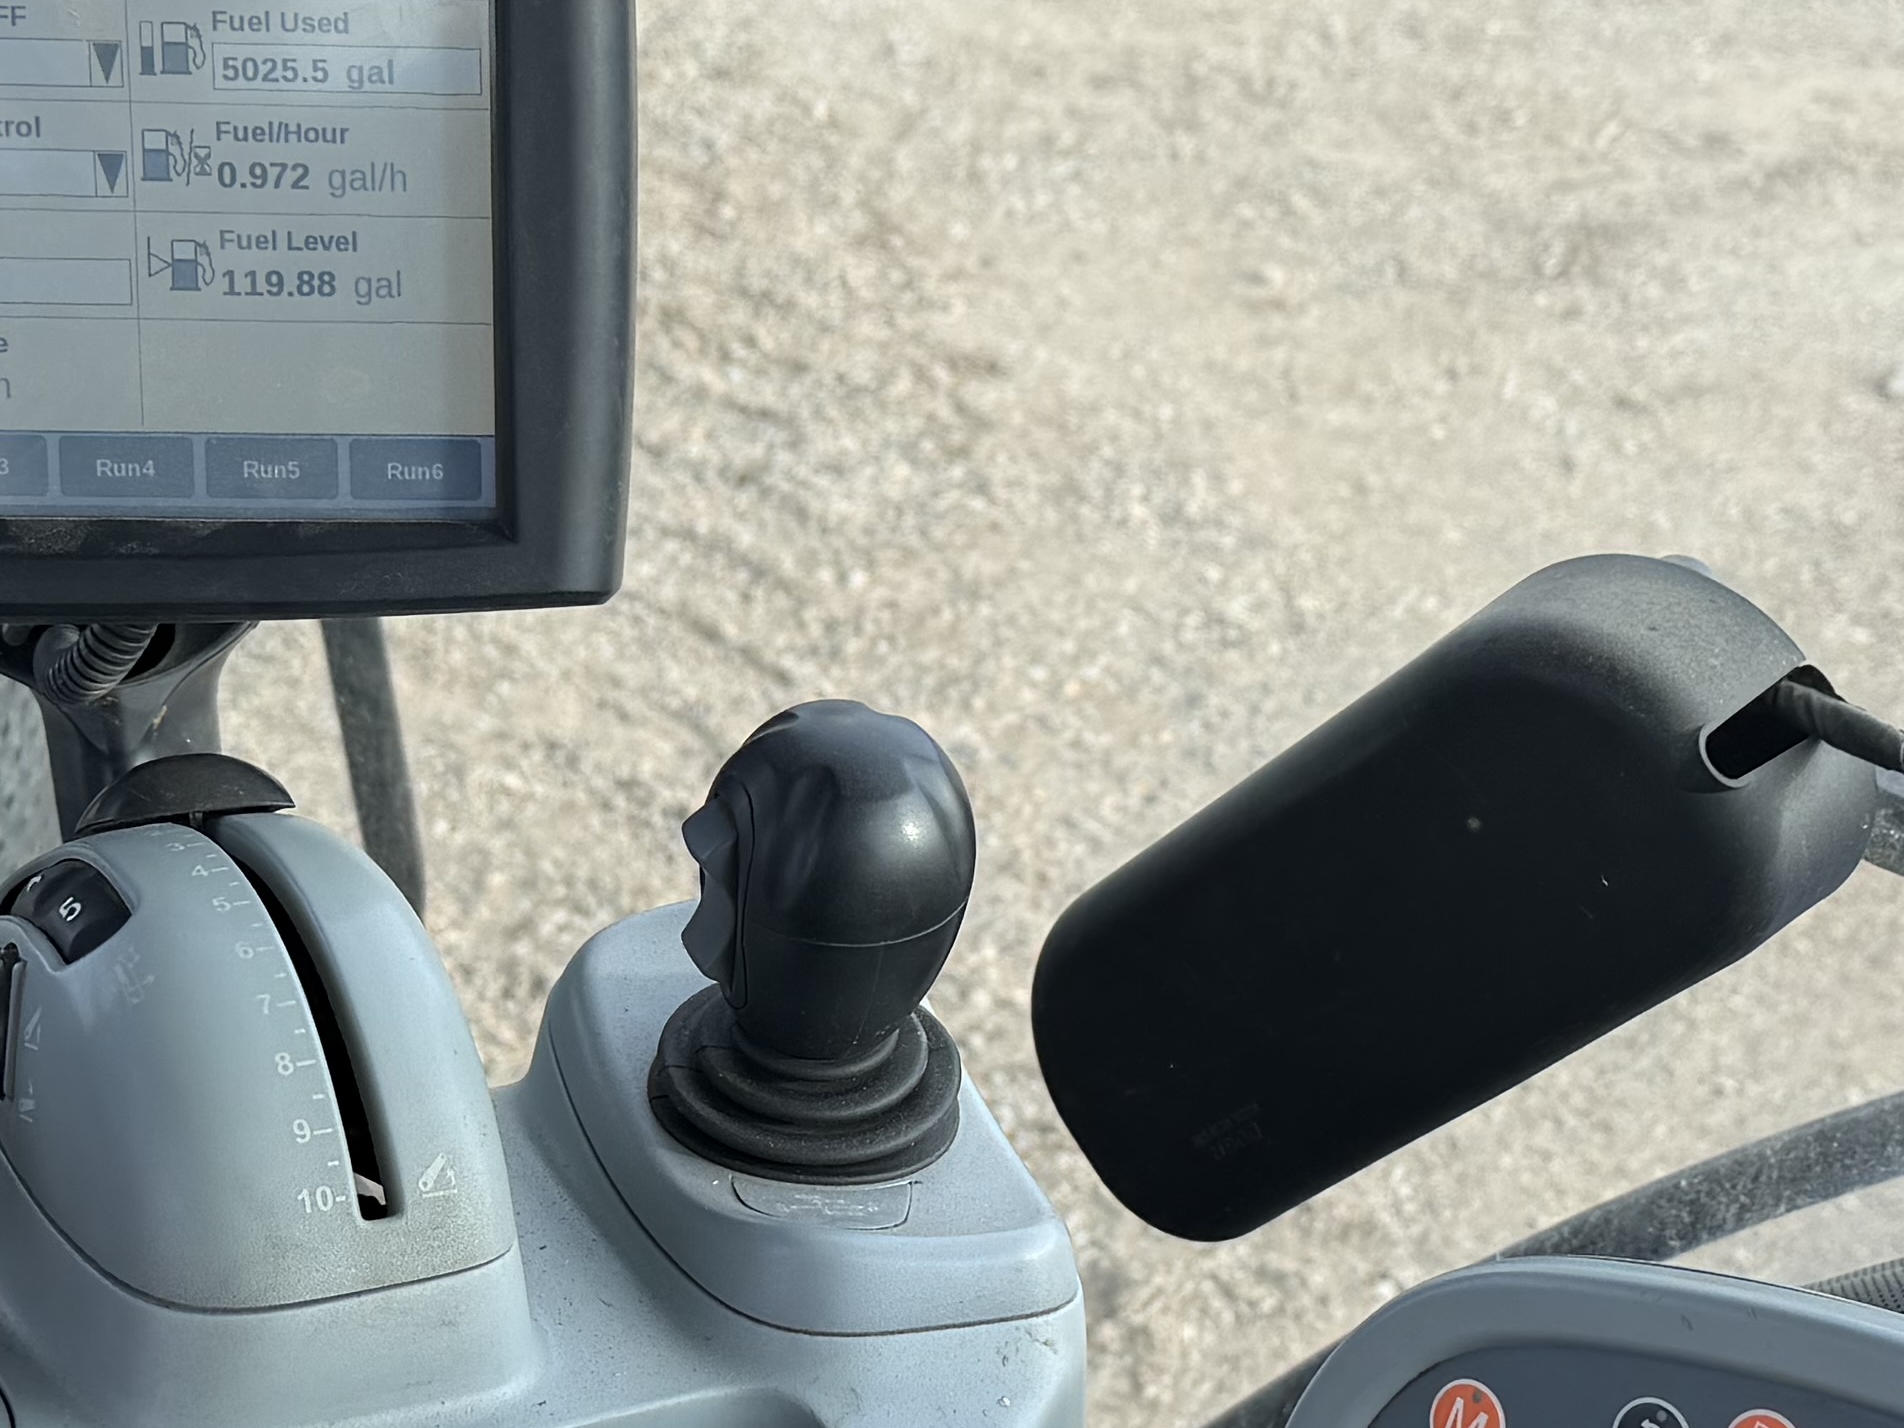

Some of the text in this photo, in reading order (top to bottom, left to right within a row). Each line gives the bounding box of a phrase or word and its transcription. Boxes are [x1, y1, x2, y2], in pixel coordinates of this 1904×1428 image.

[211, 10, 350, 35] Fuel Used
[221, 57, 395, 90] 5025.5 gal
[215, 120, 351, 145] Fuel/Hour
[217, 161, 408, 198] 0.972 gal/h
[219, 229, 358, 253] Fuel Level
[222, 270, 402, 306] 119.88 gal
[96, 459, 156, 478] Run4
[242, 460, 301, 479] Run5
[387, 462, 444, 481] Run6
[192, 864, 209, 878] 4
[59, 896, 82, 922] 5
[212, 896, 231, 913] 5
[235, 940, 255, 959] 6
[256, 994, 273, 1015] 7
[275, 1052, 295, 1076] 8
[293, 1119, 312, 1144] 9
[297, 1185, 335, 1214] 10
